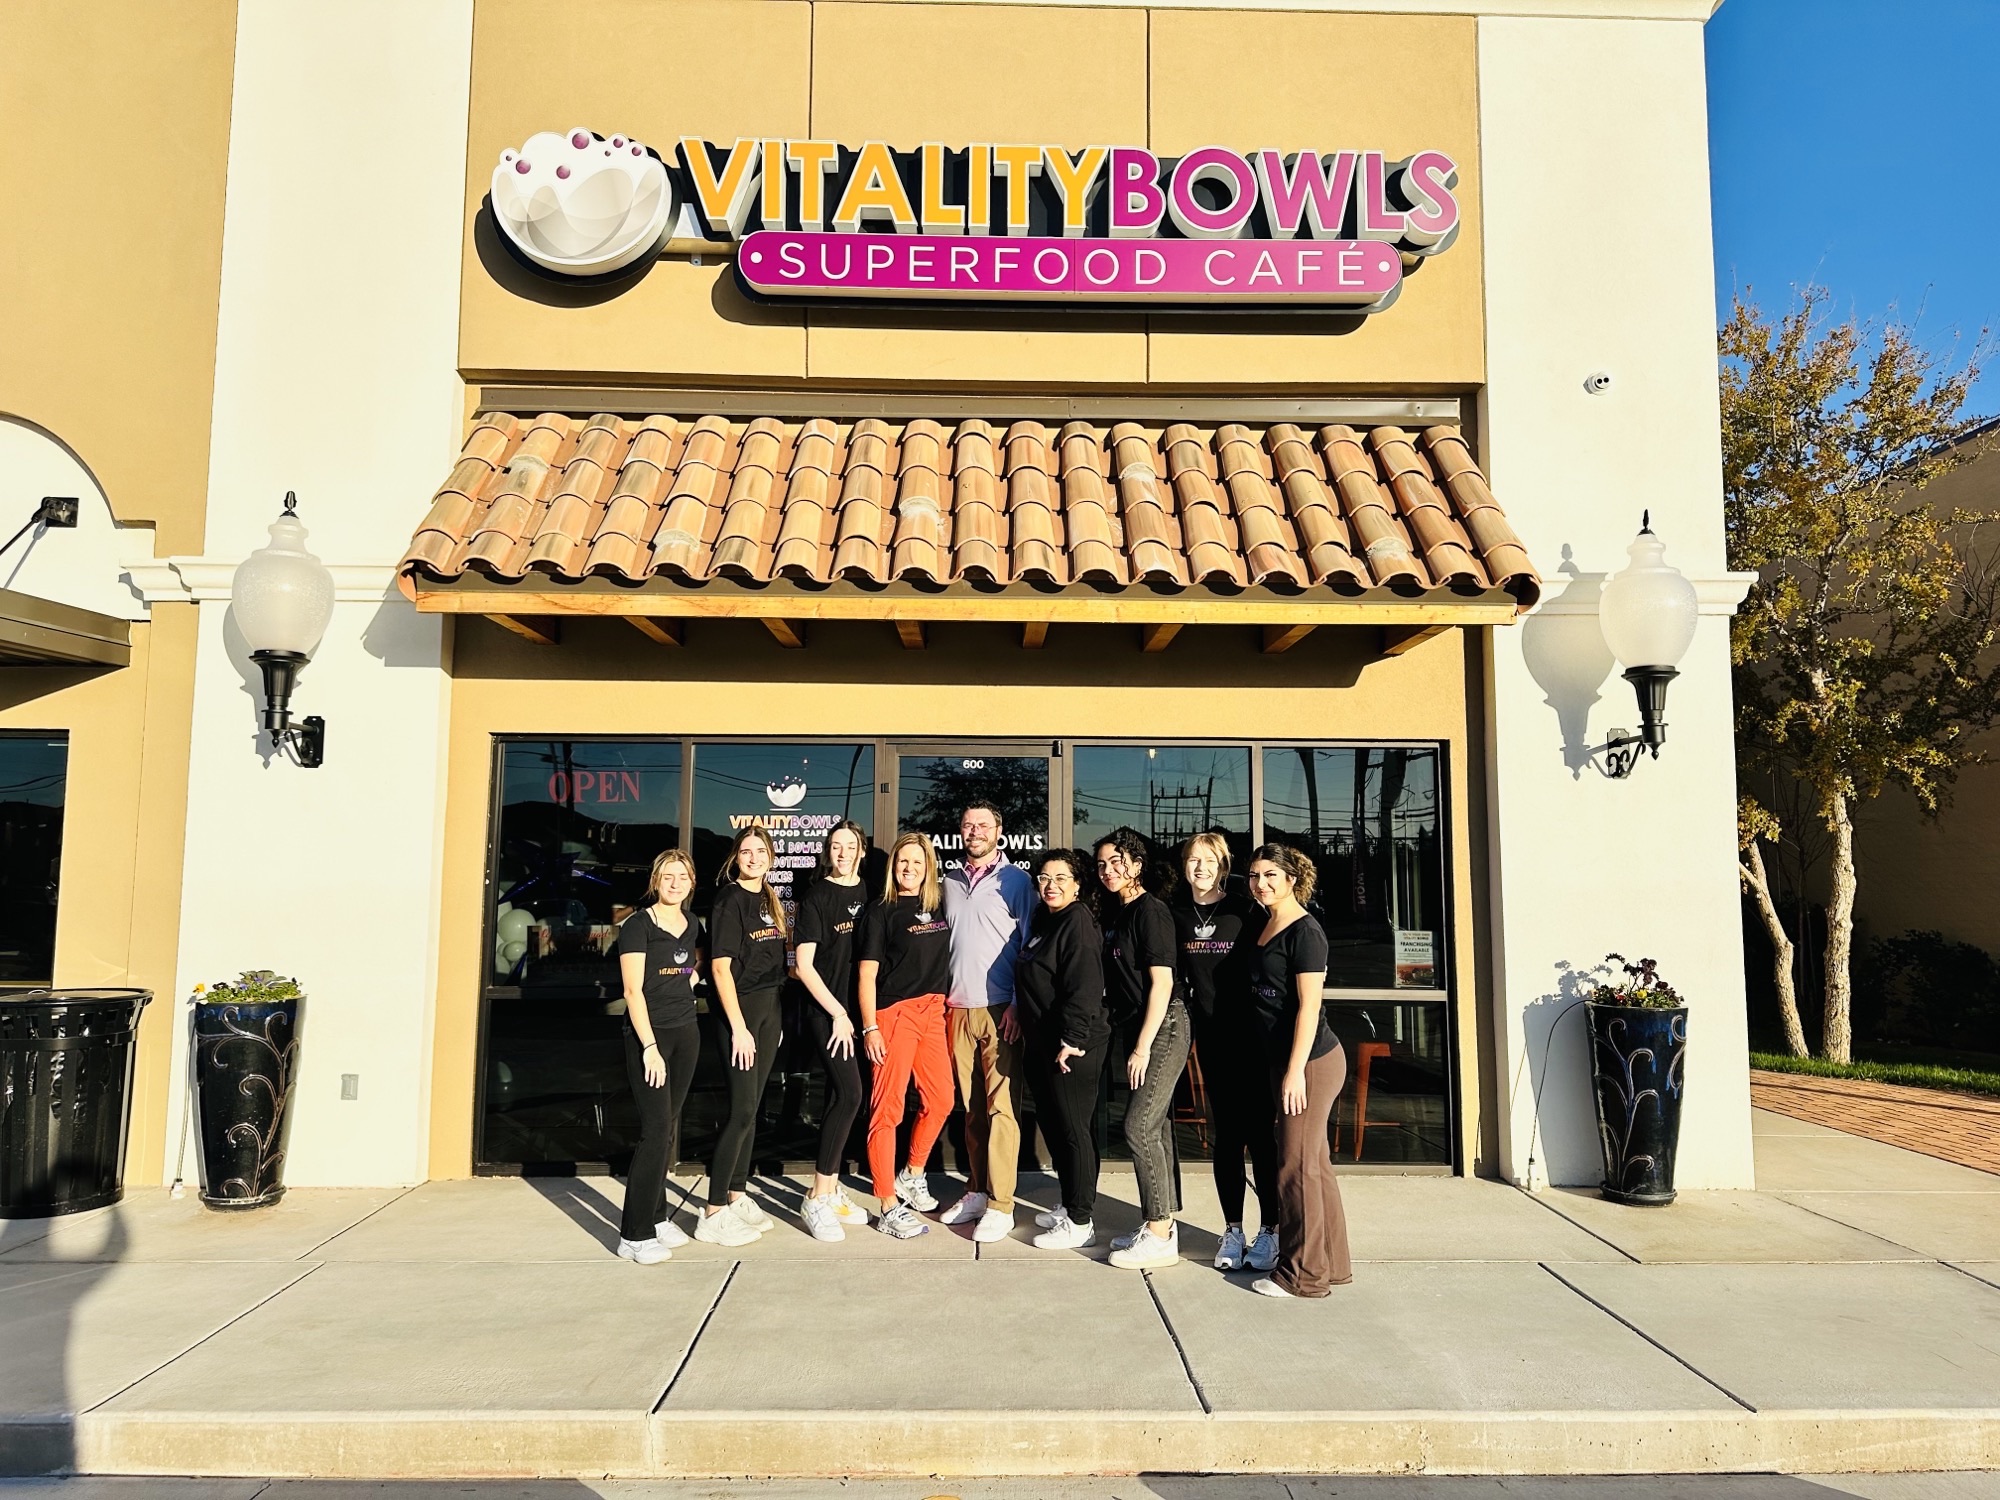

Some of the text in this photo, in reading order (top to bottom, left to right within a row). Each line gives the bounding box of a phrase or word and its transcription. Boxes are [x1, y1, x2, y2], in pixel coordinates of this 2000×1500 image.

[679, 135, 1460, 239] VITALITYBOWLS
[778, 241, 1366, 286] SUPERFOOD CAFÉ
[962, 759, 985, 769] 600
[549, 770, 640, 803] OPEN
[803, 828, 828, 837] CAFÉ
[788, 841, 823, 854] BOWLS
[996, 834, 1043, 850] OWLS
[773, 856, 817, 868] OOTHIES
